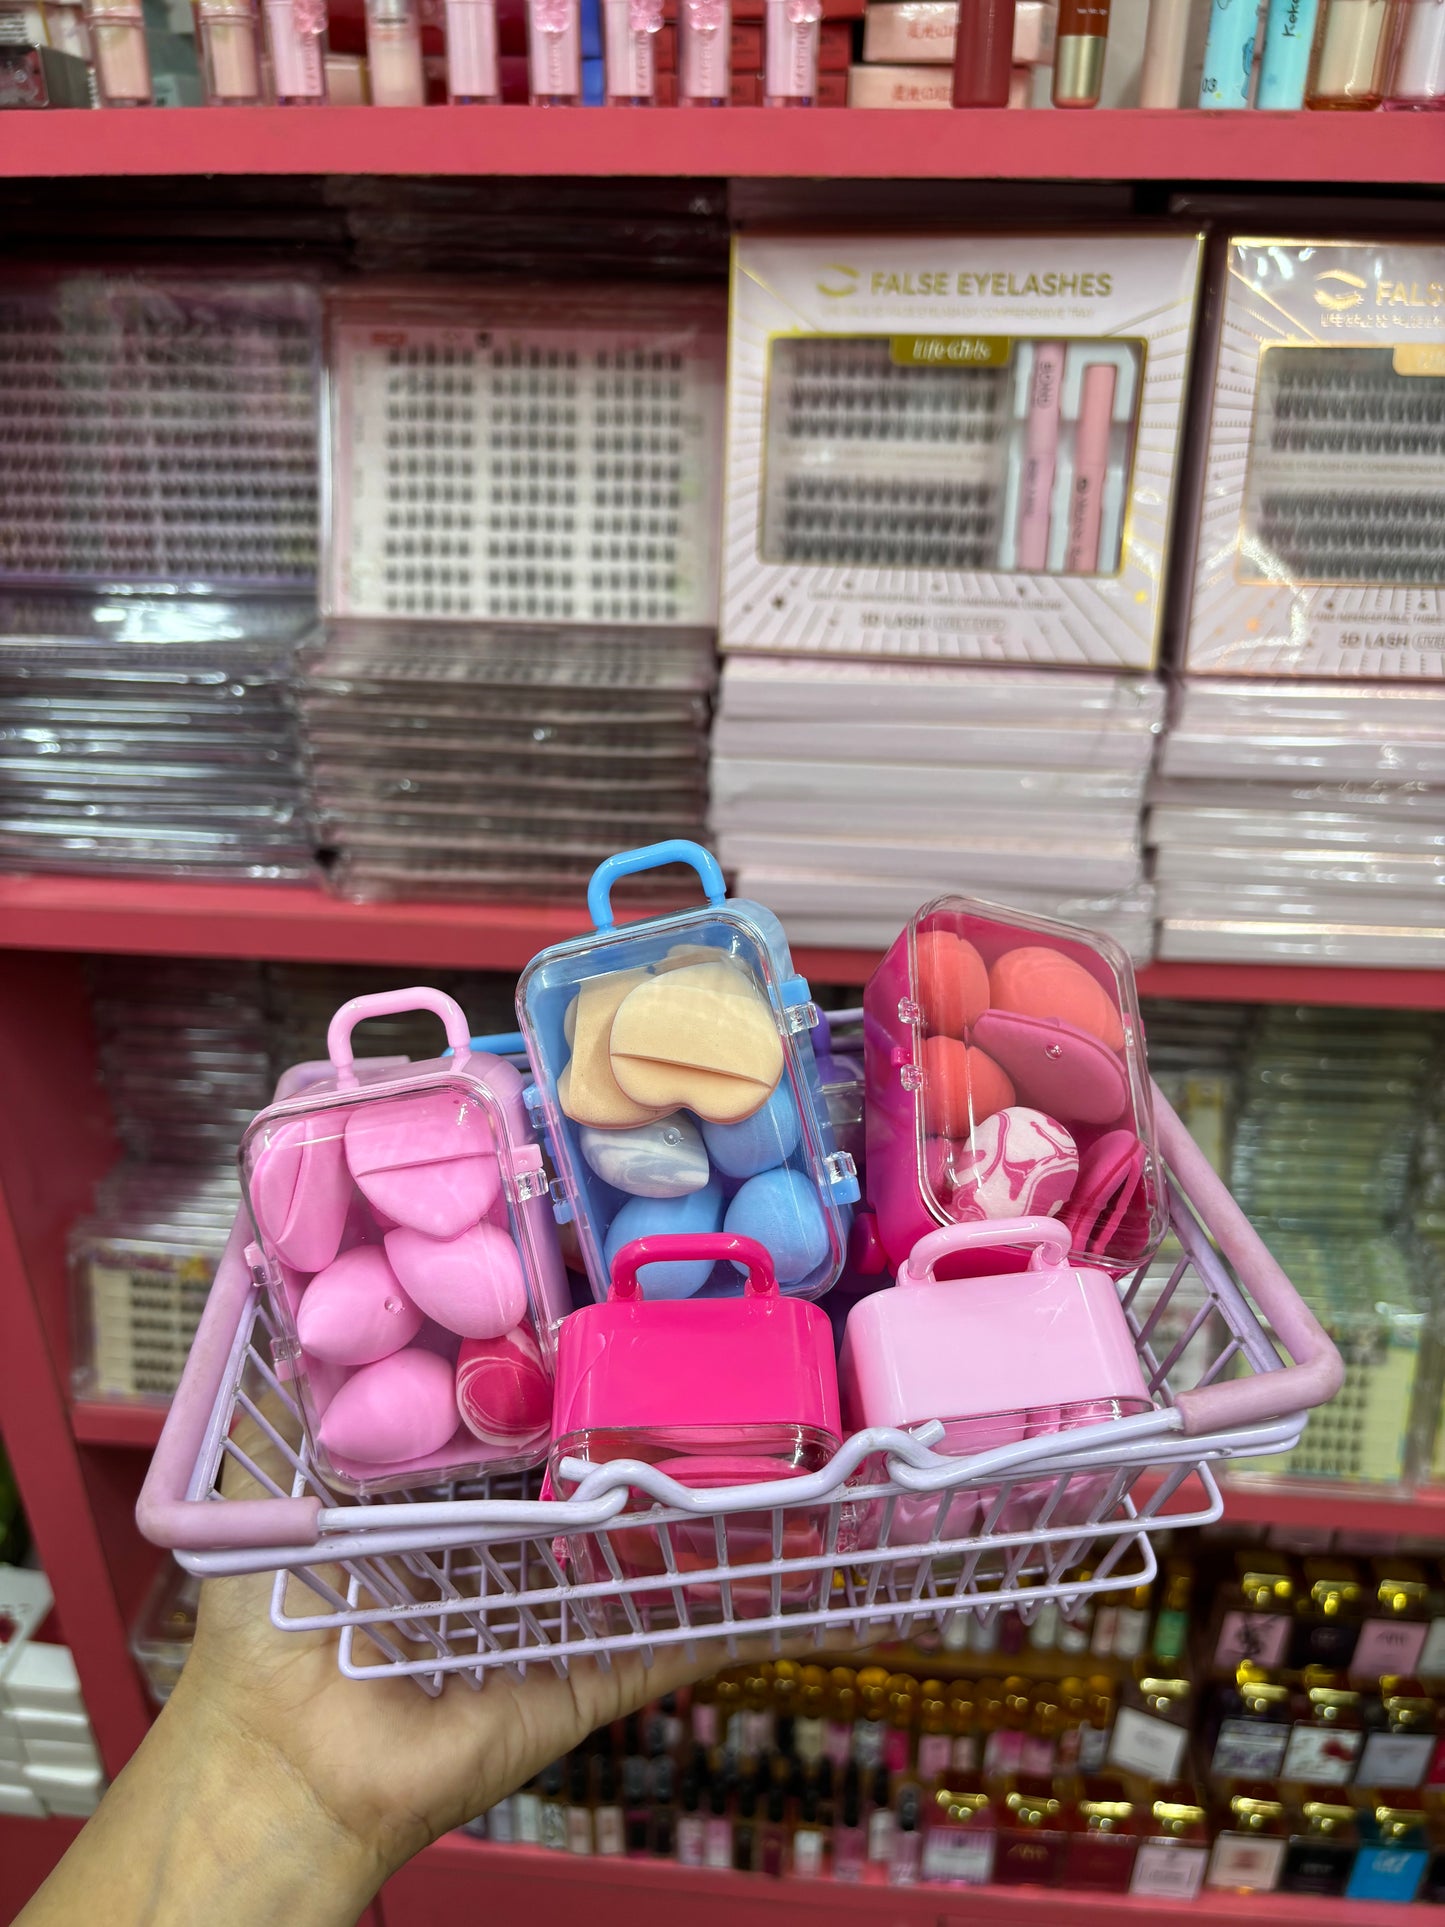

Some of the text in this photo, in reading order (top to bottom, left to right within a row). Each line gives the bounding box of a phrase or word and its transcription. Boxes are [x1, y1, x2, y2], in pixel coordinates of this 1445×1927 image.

[870, 272, 1113, 298] FALSE EYELASHES
[1364, 631, 1409, 649] LASH
